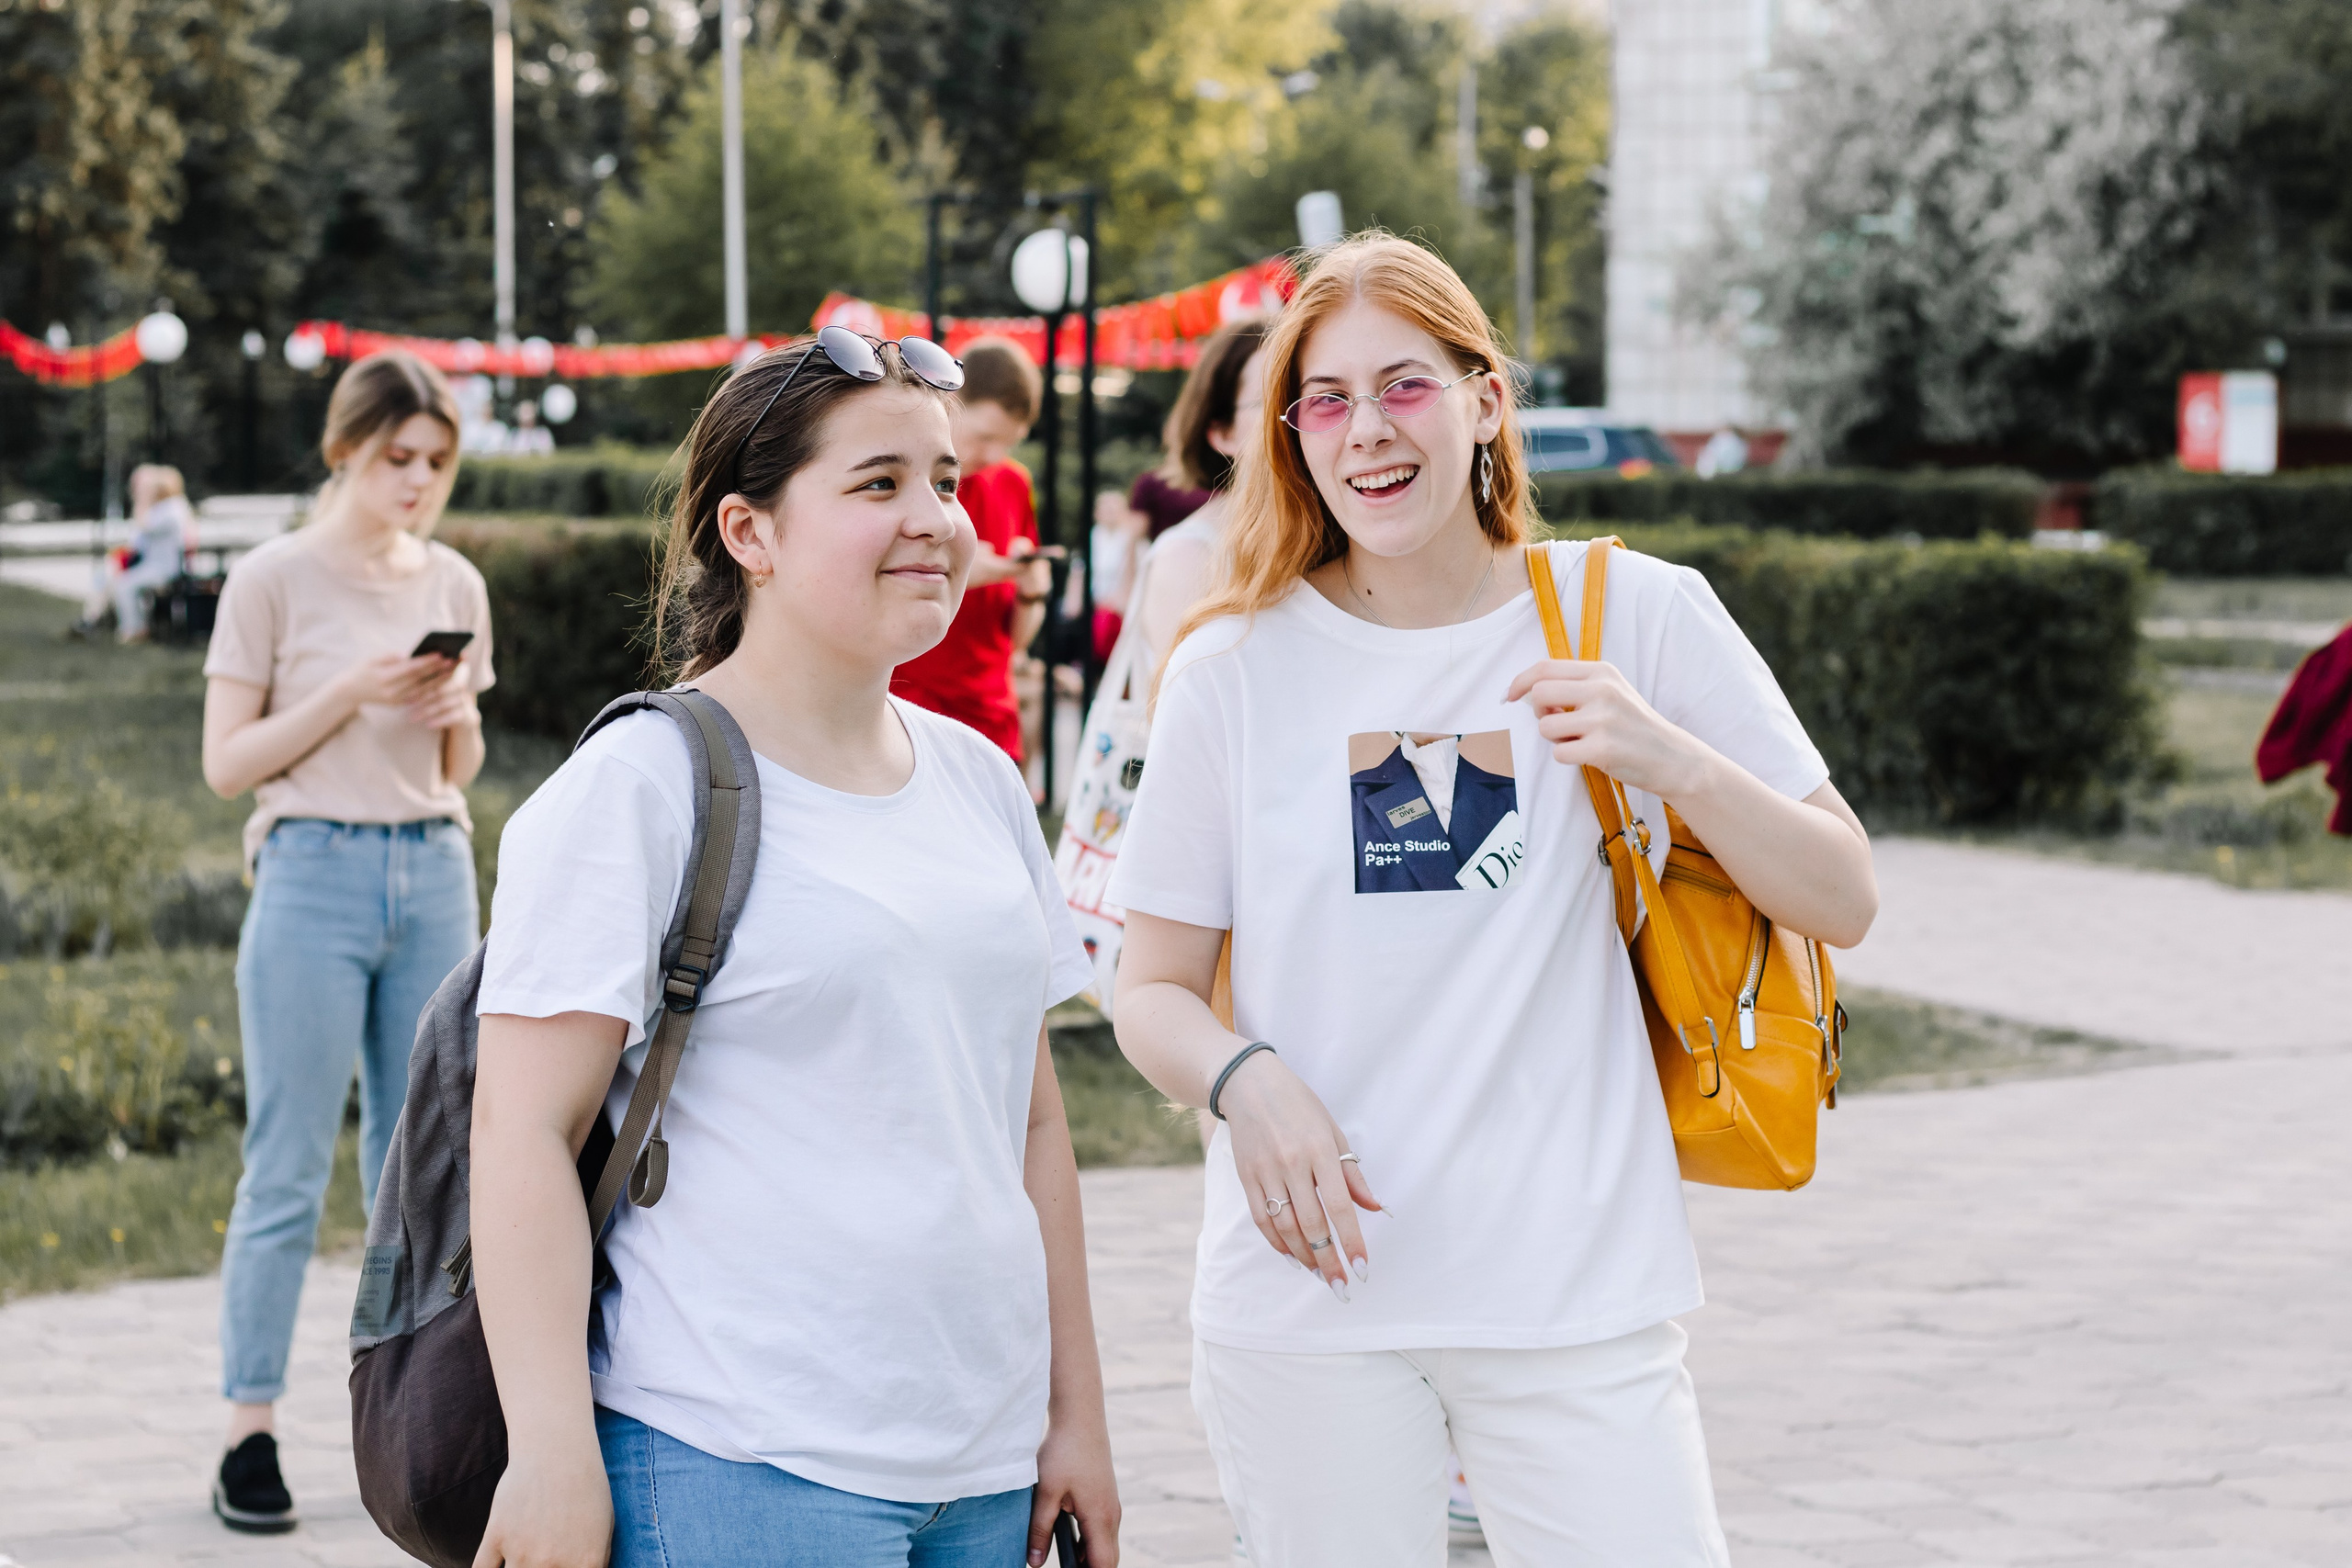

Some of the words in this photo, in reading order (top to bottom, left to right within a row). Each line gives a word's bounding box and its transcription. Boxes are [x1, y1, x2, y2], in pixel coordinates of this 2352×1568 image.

[1398, 807, 1416, 818] DIVE
[1364, 840, 1400, 852] Ance
[1404, 840, 1451, 852] Studio
[1365, 854, 1402, 866] Pa++
[1473, 834, 1523, 889] Dio
